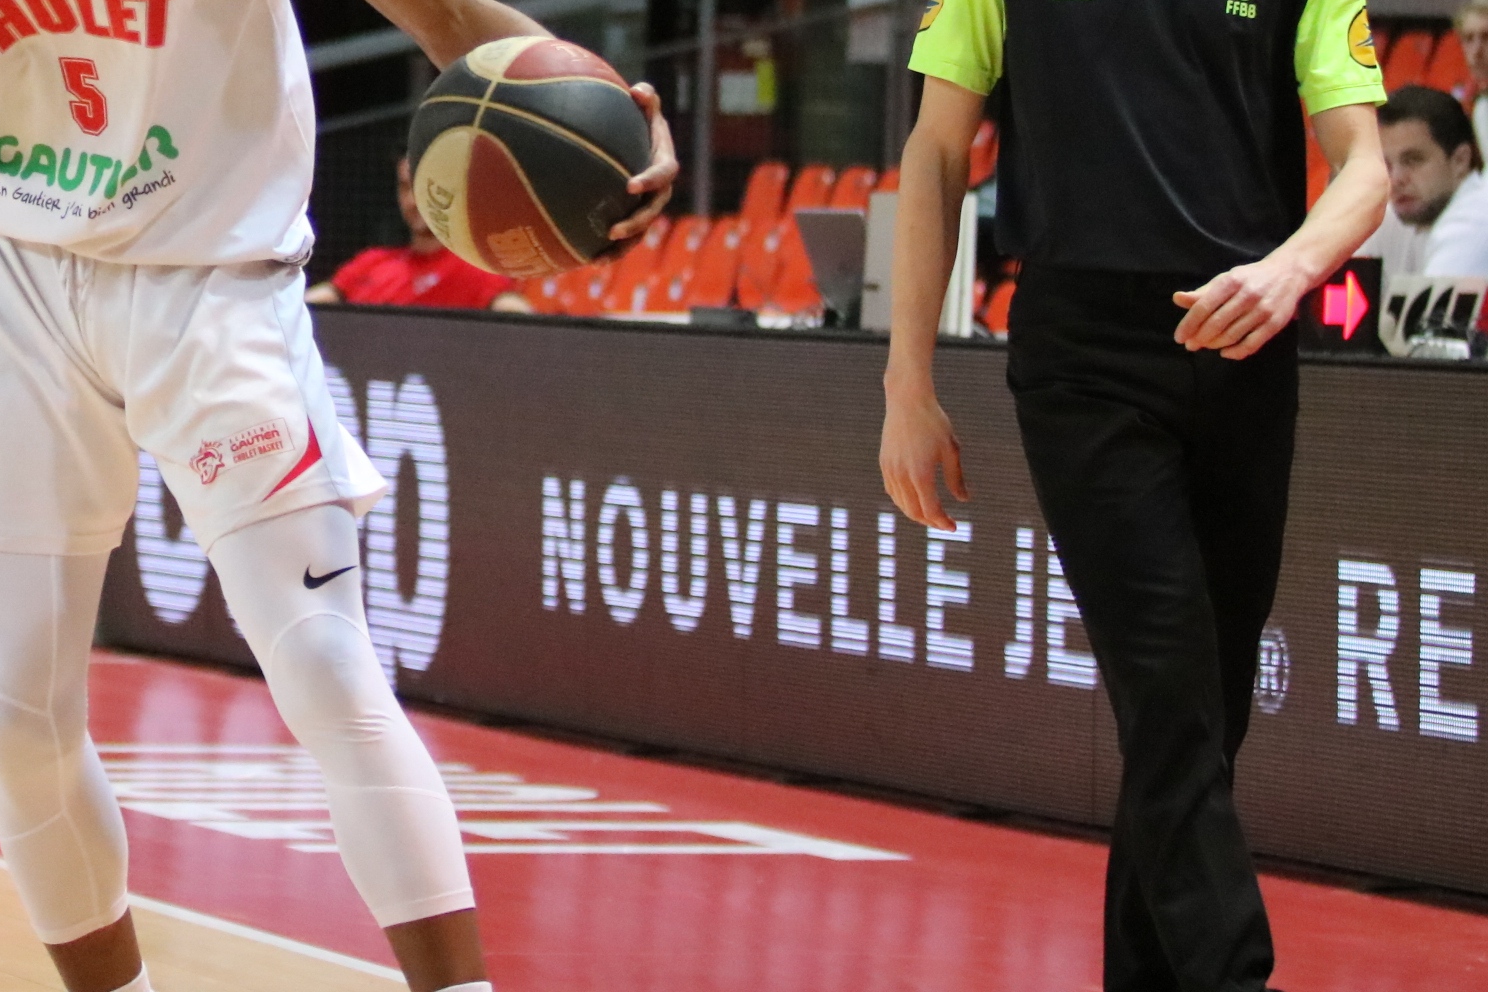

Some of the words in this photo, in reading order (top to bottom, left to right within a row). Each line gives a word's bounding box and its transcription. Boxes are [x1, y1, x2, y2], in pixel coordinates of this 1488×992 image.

[1225, 0, 1257, 19] FFBB
[58, 56, 108, 137] 5
[230, 429, 280, 452] GAUTIER
[542, 475, 974, 673] NOUVELLE
[1337, 558, 1479, 743] RE
